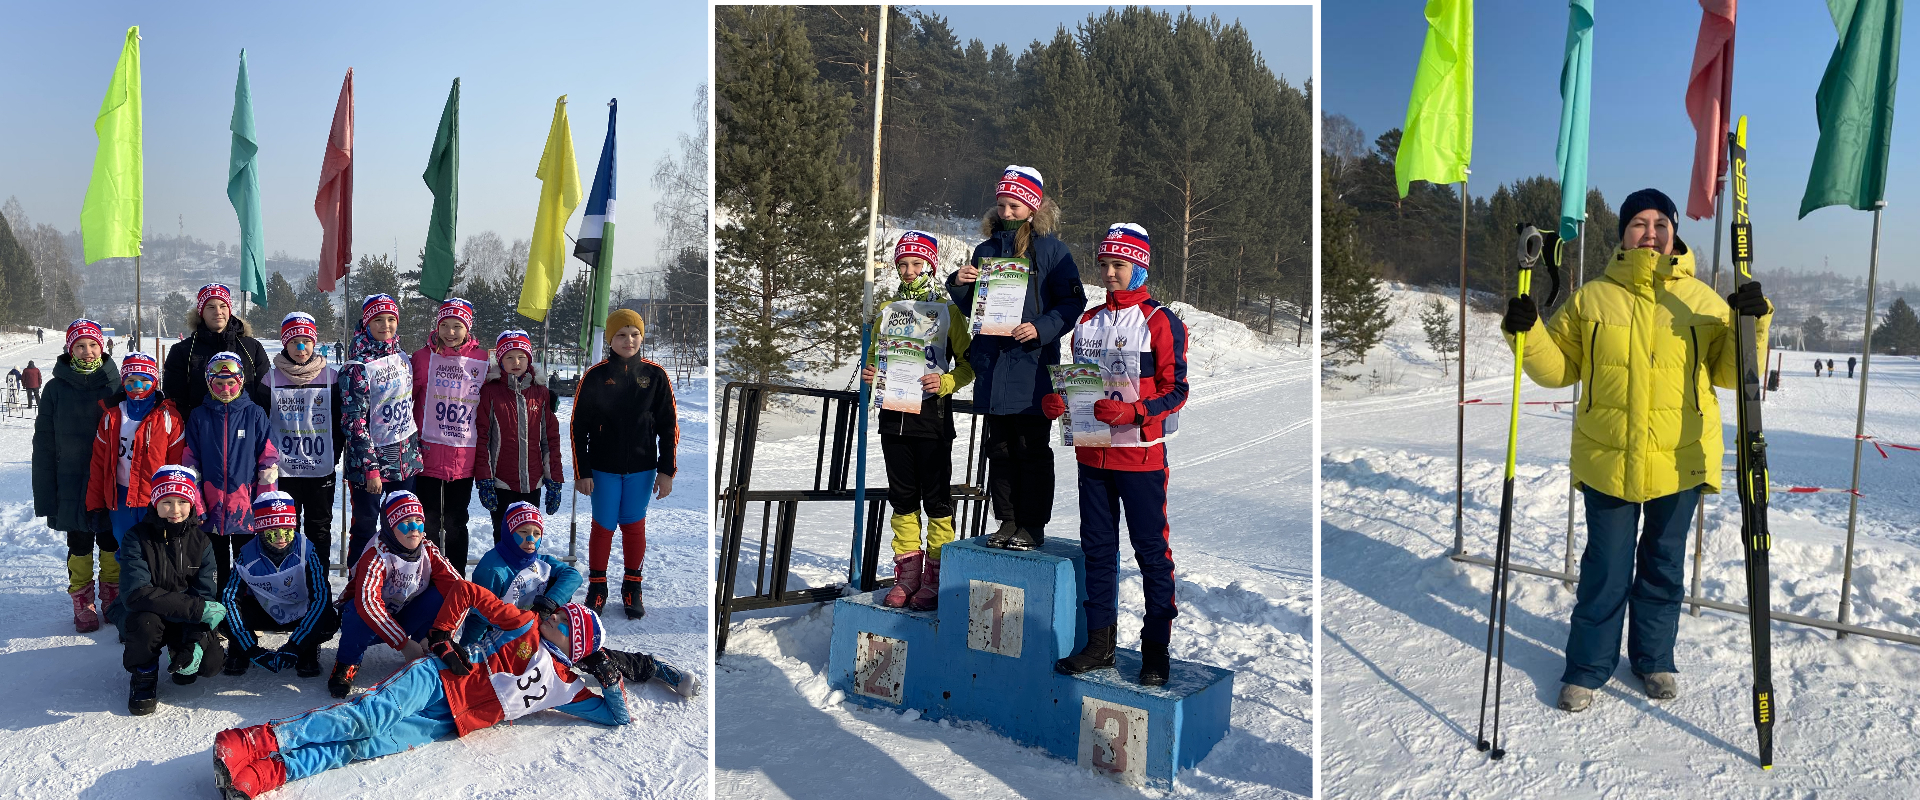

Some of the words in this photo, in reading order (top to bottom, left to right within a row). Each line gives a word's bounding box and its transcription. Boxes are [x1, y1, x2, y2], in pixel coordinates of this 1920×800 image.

[1738, 227, 1748, 258] HIDE
[888, 317, 917, 327] РОССИИ
[889, 310, 914, 321] ЛЫЖНЯ
[435, 371, 464, 380] РОССИИ
[436, 365, 464, 374] ЛЫЖНЯ
[435, 379, 462, 389] 2023
[277, 397, 305, 405] ЛЫЖНЯ
[279, 412, 304, 421] 2023
[435, 402, 475, 425] 9624
[281, 435, 325, 456] 9700
[982, 588, 1003, 649] 1
[864, 639, 893, 697] 2
[517, 666, 548, 709] 32
[1758, 692, 1769, 723] HIDE
[1092, 707, 1129, 773] 3
